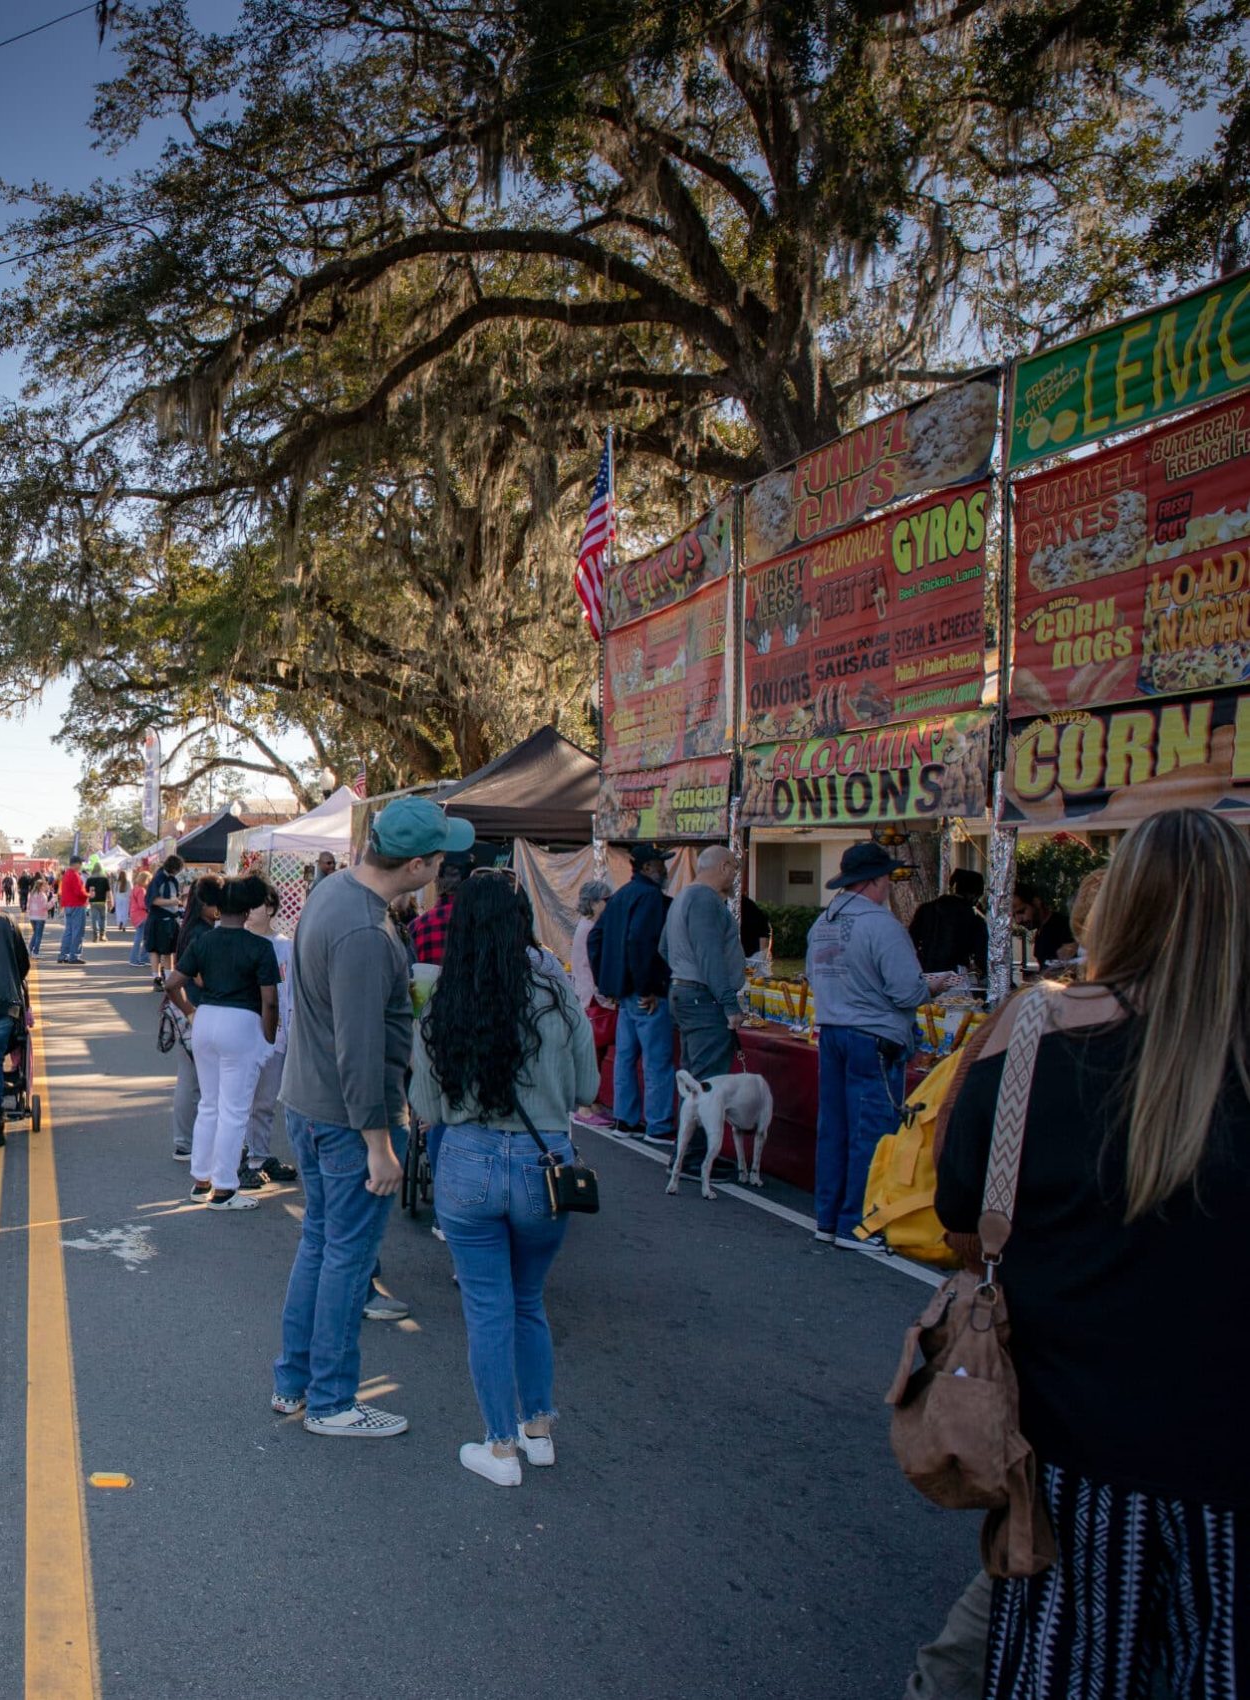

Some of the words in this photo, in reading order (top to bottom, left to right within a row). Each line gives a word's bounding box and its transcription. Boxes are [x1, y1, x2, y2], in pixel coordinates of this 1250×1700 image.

[1015, 367, 1080, 434] SQUEEZED
[1025, 361, 1065, 406] FRESH
[792, 409, 911, 502] FUNNEL
[1151, 406, 1246, 464] BUTTERFLY
[1166, 436, 1231, 481] FRENCH
[797, 459, 898, 542] CAKS
[1020, 453, 1138, 521] FUNNEL
[1158, 493, 1193, 520] FRESH
[823, 521, 886, 576] LEMONADE
[891, 489, 988, 574] GYROS
[1021, 497, 1120, 555] CAKES
[1156, 519, 1188, 545] CUT
[748, 556, 807, 600] TURKEY
[919, 573, 953, 593] Chicken,
[956, 566, 982, 583] Lamb
[1151, 546, 1250, 610] LOAD
[760, 583, 797, 620] LEGS
[1035, 596, 1116, 645] CORN
[815, 643, 846, 660] ITALIAN
[857, 631, 890, 650] POLISH
[894, 621, 925, 654] STEAK
[928, 621, 937, 644] &
[940, 608, 981, 642] CHEESE
[1052, 626, 1134, 671] DOGS
[815, 647, 890, 681] SAUSAGE
[750, 671, 811, 710] ONIONS
[1050, 711, 1091, 727] DIPPED
[771, 718, 947, 781] BLOOMIN'
[1014, 700, 1213, 799] CORN
[672, 784, 728, 810] CHICKEN
[771, 762, 948, 822] ONIONS
[675, 811, 721, 834] STRIPS
